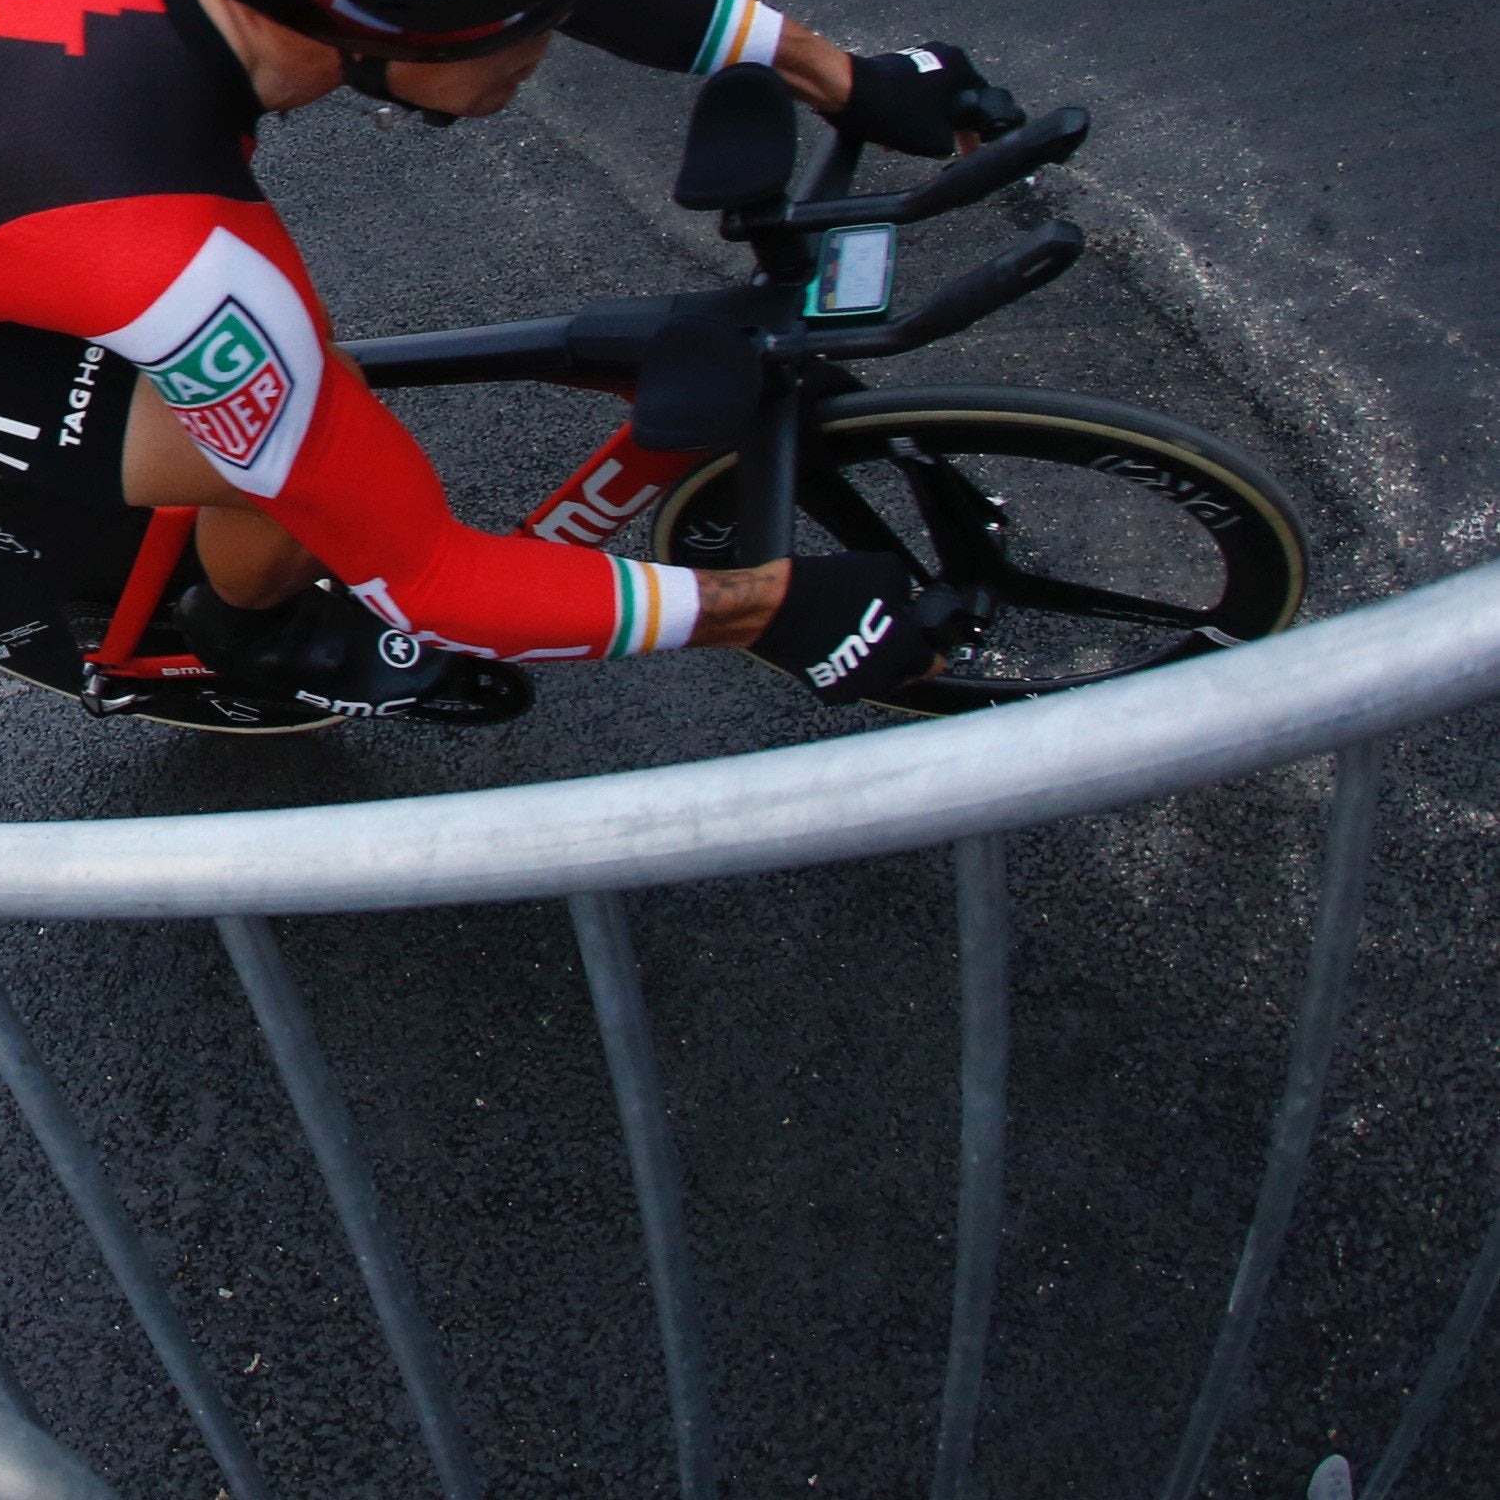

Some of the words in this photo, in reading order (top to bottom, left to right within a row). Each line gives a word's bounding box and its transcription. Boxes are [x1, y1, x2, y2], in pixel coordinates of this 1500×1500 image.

[534, 457, 661, 546] MC
[805, 598, 892, 688] BMC
[296, 690, 418, 718] BMC
